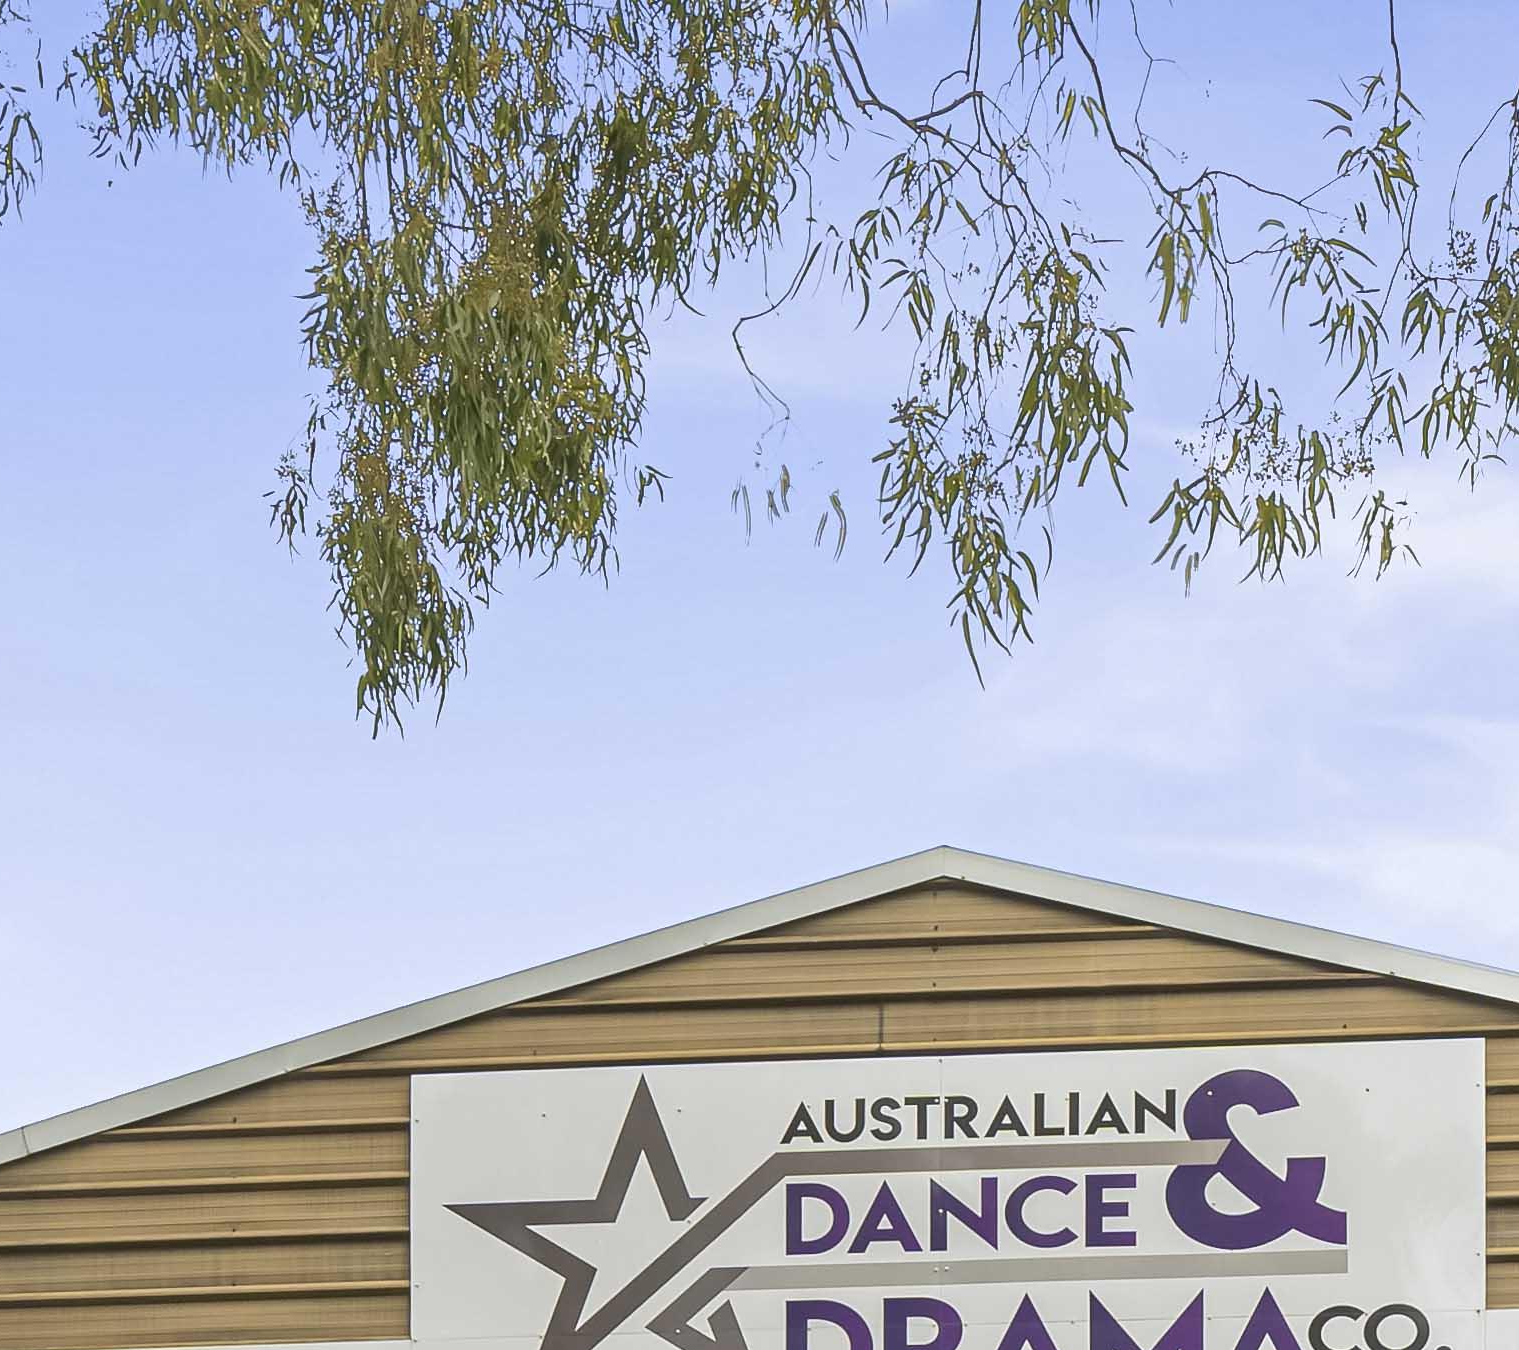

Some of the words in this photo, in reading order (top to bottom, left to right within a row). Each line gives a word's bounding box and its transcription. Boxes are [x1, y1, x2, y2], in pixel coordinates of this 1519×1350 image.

[780, 1089, 1178, 1145] AUSTRALIAN
[785, 1173, 1137, 1256] DANCE
[1165, 1069, 1347, 1250] &
